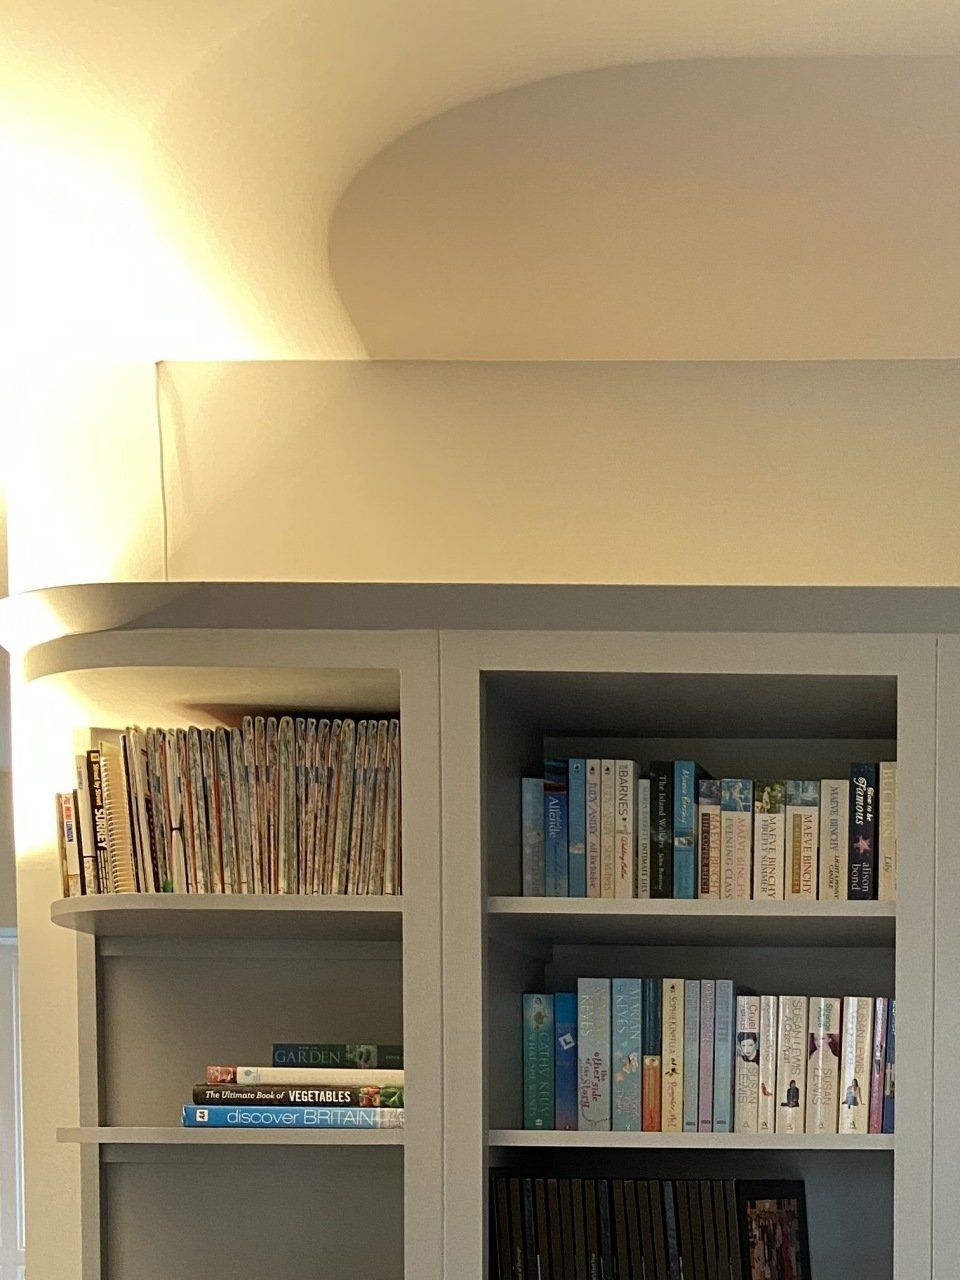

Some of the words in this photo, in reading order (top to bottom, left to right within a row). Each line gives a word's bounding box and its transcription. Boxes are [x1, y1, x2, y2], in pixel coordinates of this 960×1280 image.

[618, 770, 629, 817] BARNES
[829, 786, 839, 817] MAEVE
[853, 777, 867, 826] Famous
[549, 796, 560, 839] Allende
[803, 815, 813, 853] MAEVE
[829, 819, 839, 851] BINCHY
[802, 855, 812, 895] BINCHY
[850, 863, 861, 891] bond
[861, 862, 873, 893] alison
[616, 995, 629, 1034] KEYES
[748, 1004, 758, 1030] Cruel
[791, 999, 803, 1039] SUSAN
[856, 999, 867, 1038] SUSAN
[274, 1049, 341, 1065] GARDEN
[791, 1042, 803, 1076] LEWIS
[856, 1041, 867, 1074] LEWIS
[205, 1090, 220, 1099] The
[221, 1090, 255, 1099] Ultimate
[256, 1090, 275, 1099] Book
[275, 1090, 285, 1099] of
[289, 1089, 351, 1103] VEGETABLES
[821, 1068, 833, 1106] SUSAN
[227, 1109, 297, 1125] discover
[302, 1109, 375, 1126] BRITAIN
